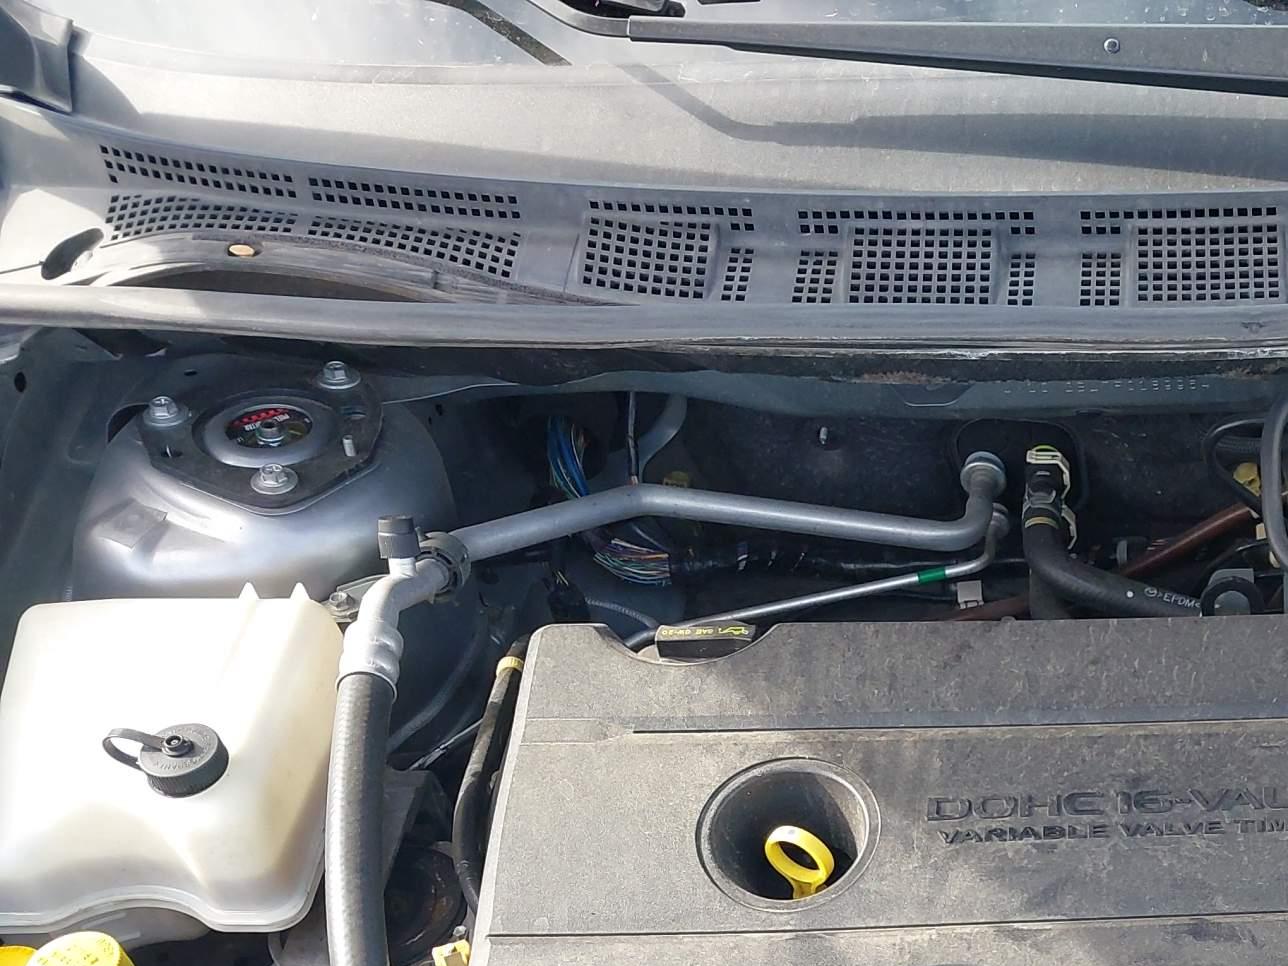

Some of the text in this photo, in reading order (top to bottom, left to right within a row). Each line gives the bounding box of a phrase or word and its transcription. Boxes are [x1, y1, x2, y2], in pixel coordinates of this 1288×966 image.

[926, 791, 1103, 823] DOHC
[938, 823, 1108, 845] VARIABLE
[1118, 819, 1225, 838] VALVE
